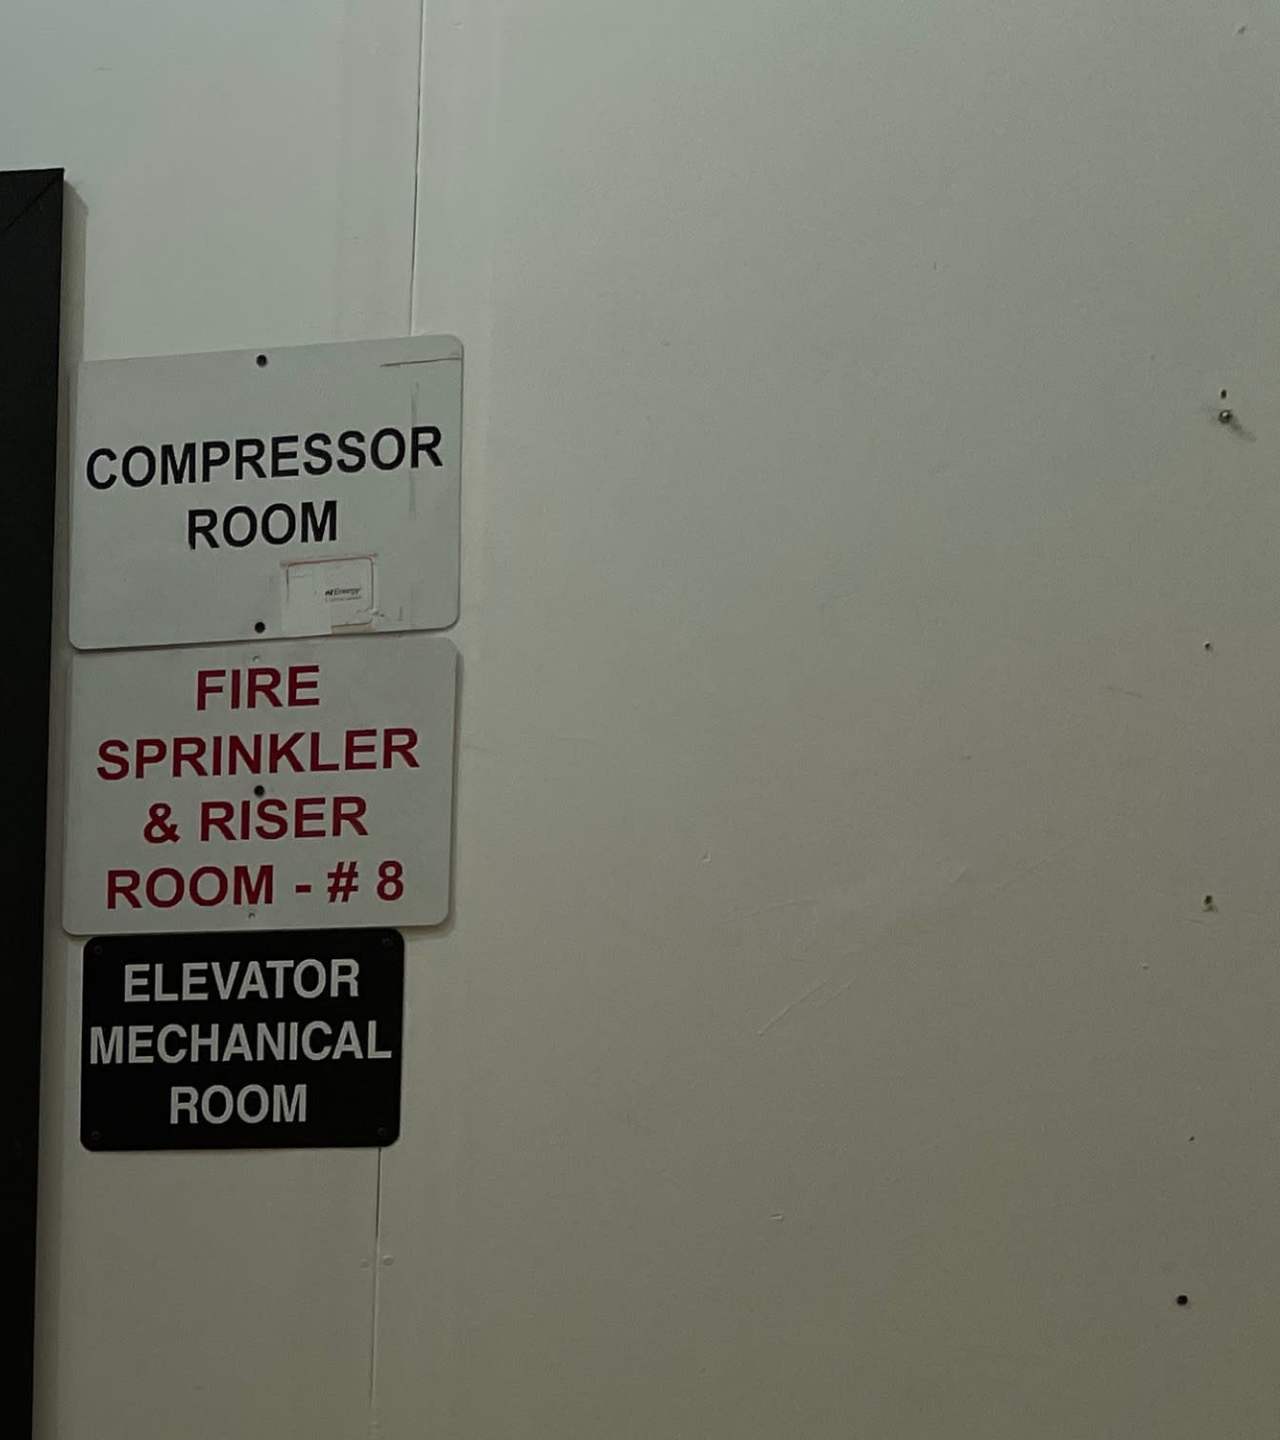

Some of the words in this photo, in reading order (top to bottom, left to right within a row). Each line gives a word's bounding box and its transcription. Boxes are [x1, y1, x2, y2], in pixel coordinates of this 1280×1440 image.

[86, 425, 443, 490] COMPRESSOR
[187, 500, 338, 550] ROOM
[196, 664, 321, 711] FIRE
[96, 727, 420, 780] SPRINKLER
[142, 803, 180, 844] &
[200, 796, 369, 842] RISER
[106, 864, 275, 910] ROOM
[295, 883, 312, 895] -
[327, 861, 359, 903] #
[376, 860, 404, 901] 8
[123, 958, 360, 1002] ELEVATOR
[89, 1020, 393, 1065] MECHANICAL
[169, 1083, 308, 1125] ROOM
